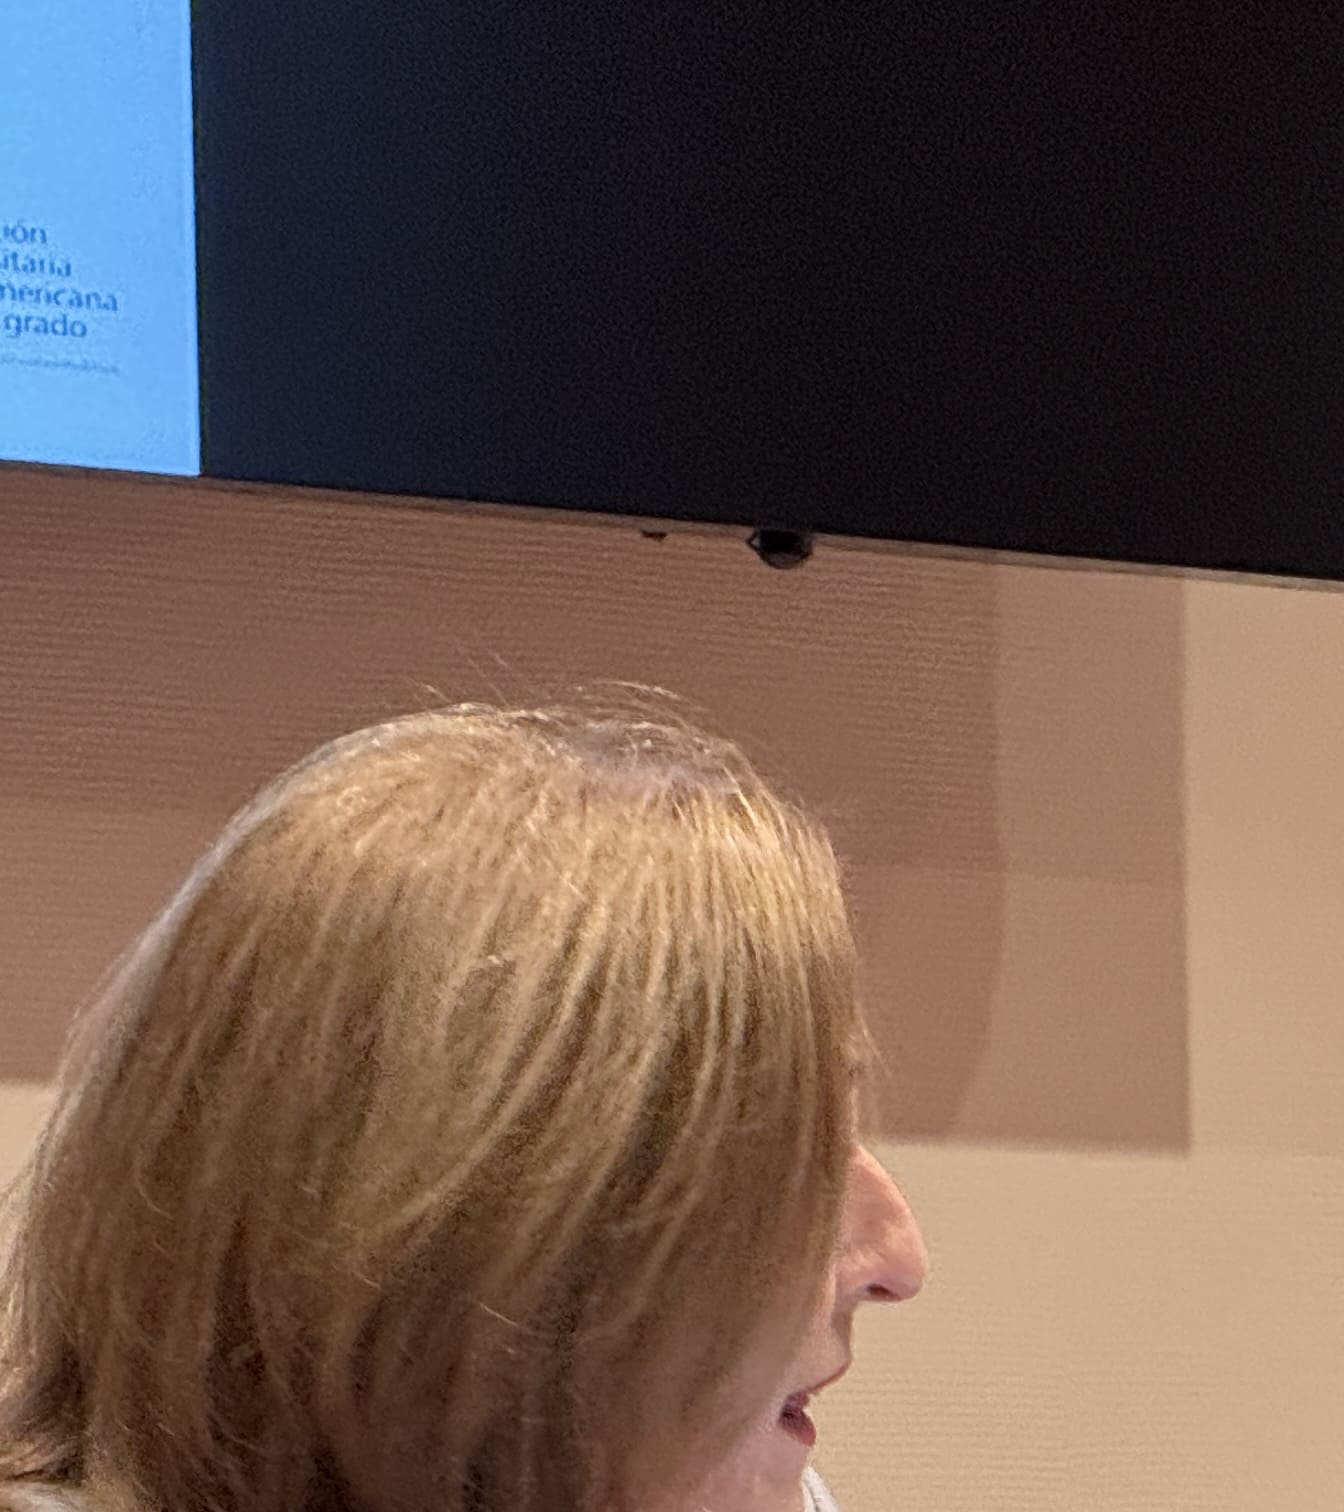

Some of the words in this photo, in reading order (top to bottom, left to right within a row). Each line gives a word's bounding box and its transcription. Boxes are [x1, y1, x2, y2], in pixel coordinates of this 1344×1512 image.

[0, 219, 47, 244] ión
[0, 251, 72, 277] itaria
[3, 313, 88, 338] grado
